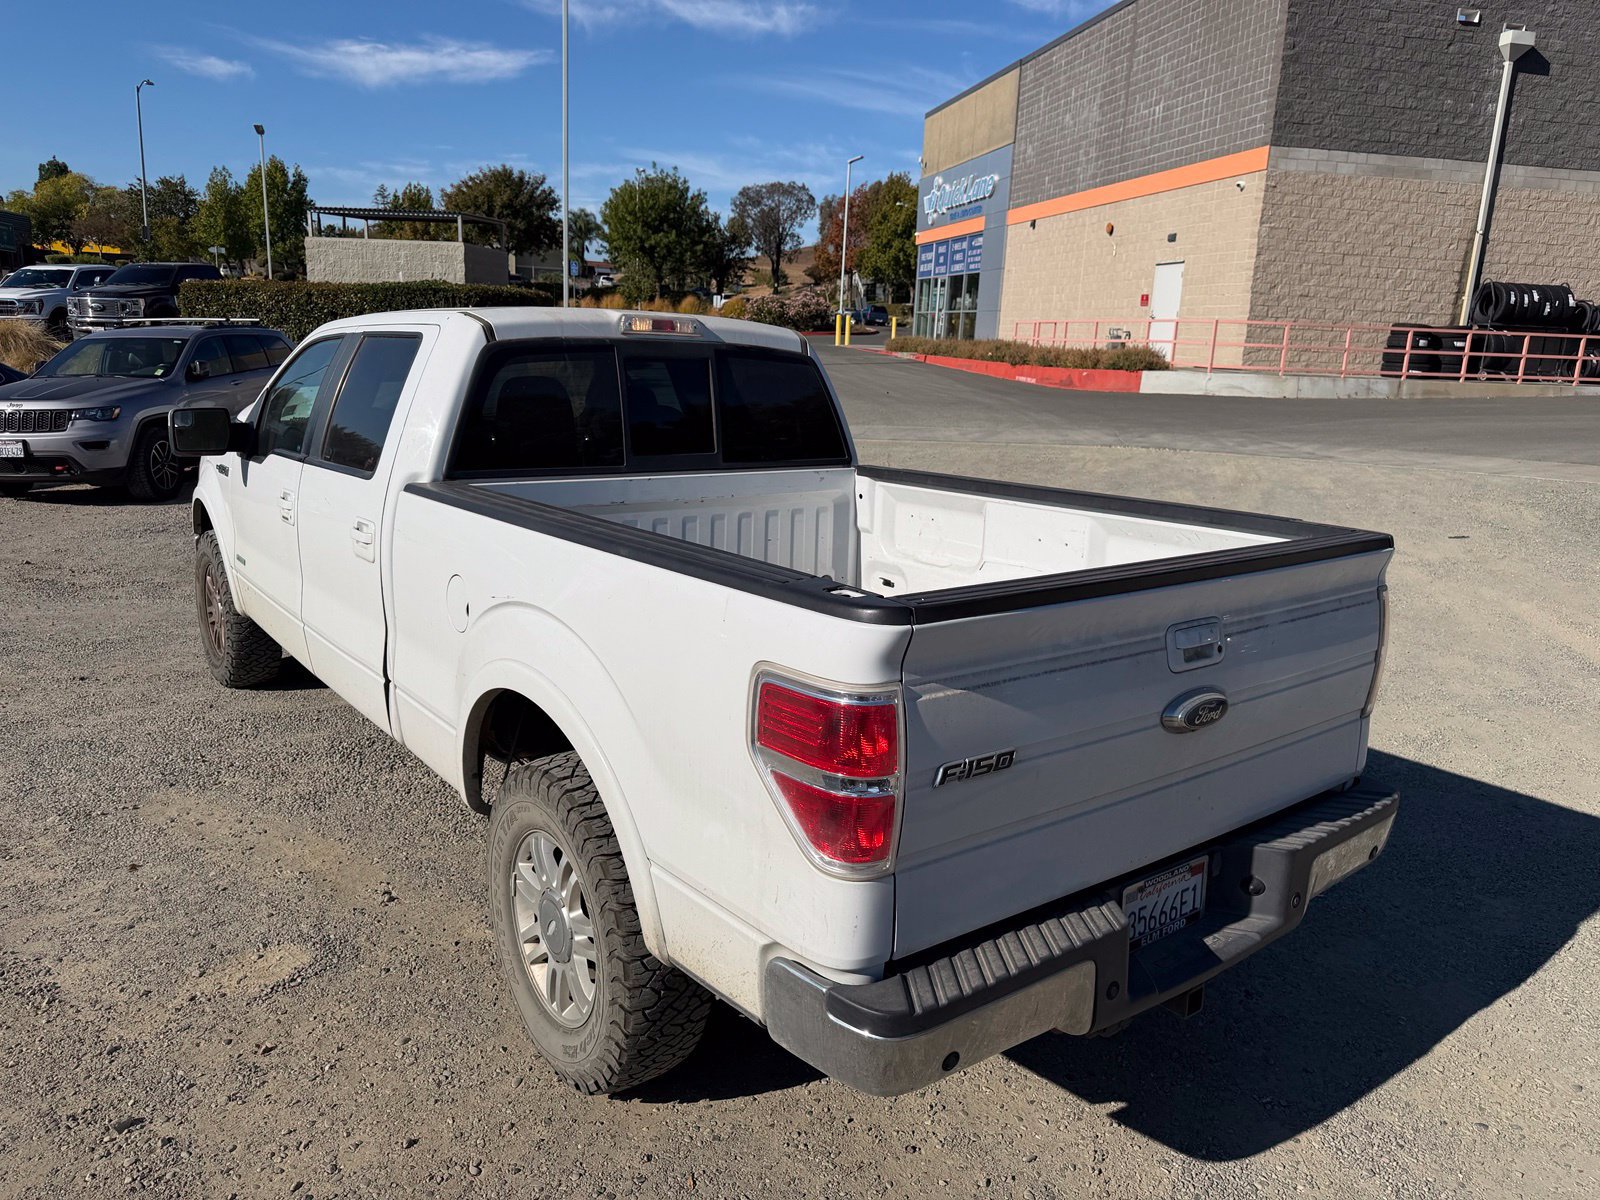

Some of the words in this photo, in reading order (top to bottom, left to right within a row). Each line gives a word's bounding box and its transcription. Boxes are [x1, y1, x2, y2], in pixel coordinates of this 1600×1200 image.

[937, 176, 968, 214] Quick
[965, 174, 995, 203] Lane
[1194, 702, 1222, 725] Ford
[930, 746, 1016, 790] F-150
[1145, 865, 1190, 887] WOODLAND
[1128, 884, 1198, 939] 35666E1
[1141, 929, 1160, 946] ELM
[1162, 918, 1186, 937] FORD
